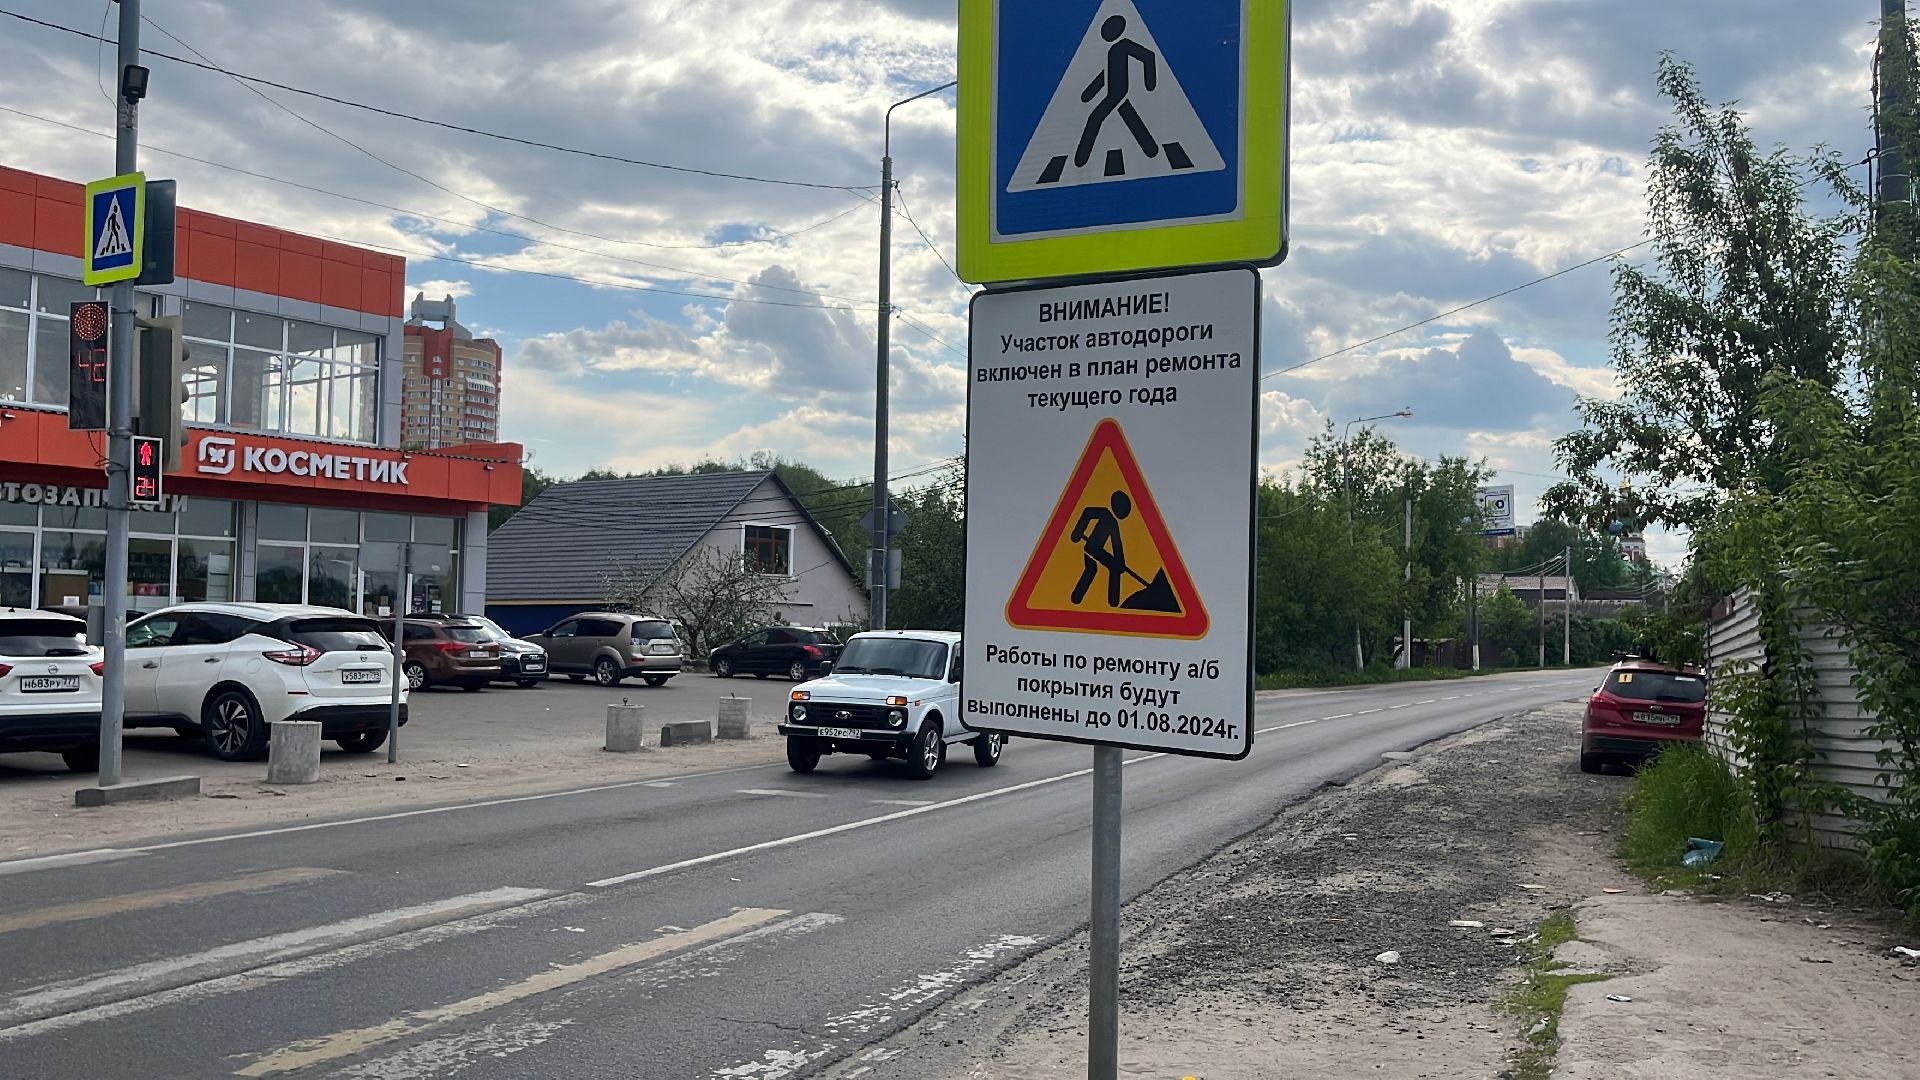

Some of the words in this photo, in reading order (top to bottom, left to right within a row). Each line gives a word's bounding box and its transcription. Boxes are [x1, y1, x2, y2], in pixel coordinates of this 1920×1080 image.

[1039, 292, 1169, 323] ВНИМАНИЕ!
[1000, 333, 1080, 353] Участок
[1085, 323, 1213, 349] автодороги
[977, 363, 1062, 383] включен
[1068, 362, 1081, 378] в
[1087, 360, 1138, 377] план
[1145, 352, 1241, 379] ремонта
[1027, 389, 1123, 412] текущего
[1128, 386, 1177, 407] года
[243, 446, 409, 485] КОСМЕТИК
[135, 477, 155, 497] 24
[986, 644, 1057, 668] Работы
[1063, 654, 1088, 670] по
[1093, 656, 1181, 682] ремонту
[1187, 658, 1220, 680] а/б
[1017, 677, 1114, 699] покрытия
[1119, 681, 1181, 709] будут
[967, 699, 1080, 724] выполнены
[1084, 710, 1112, 729] до
[1117, 708, 1239, 740] 01.08.2024г.
